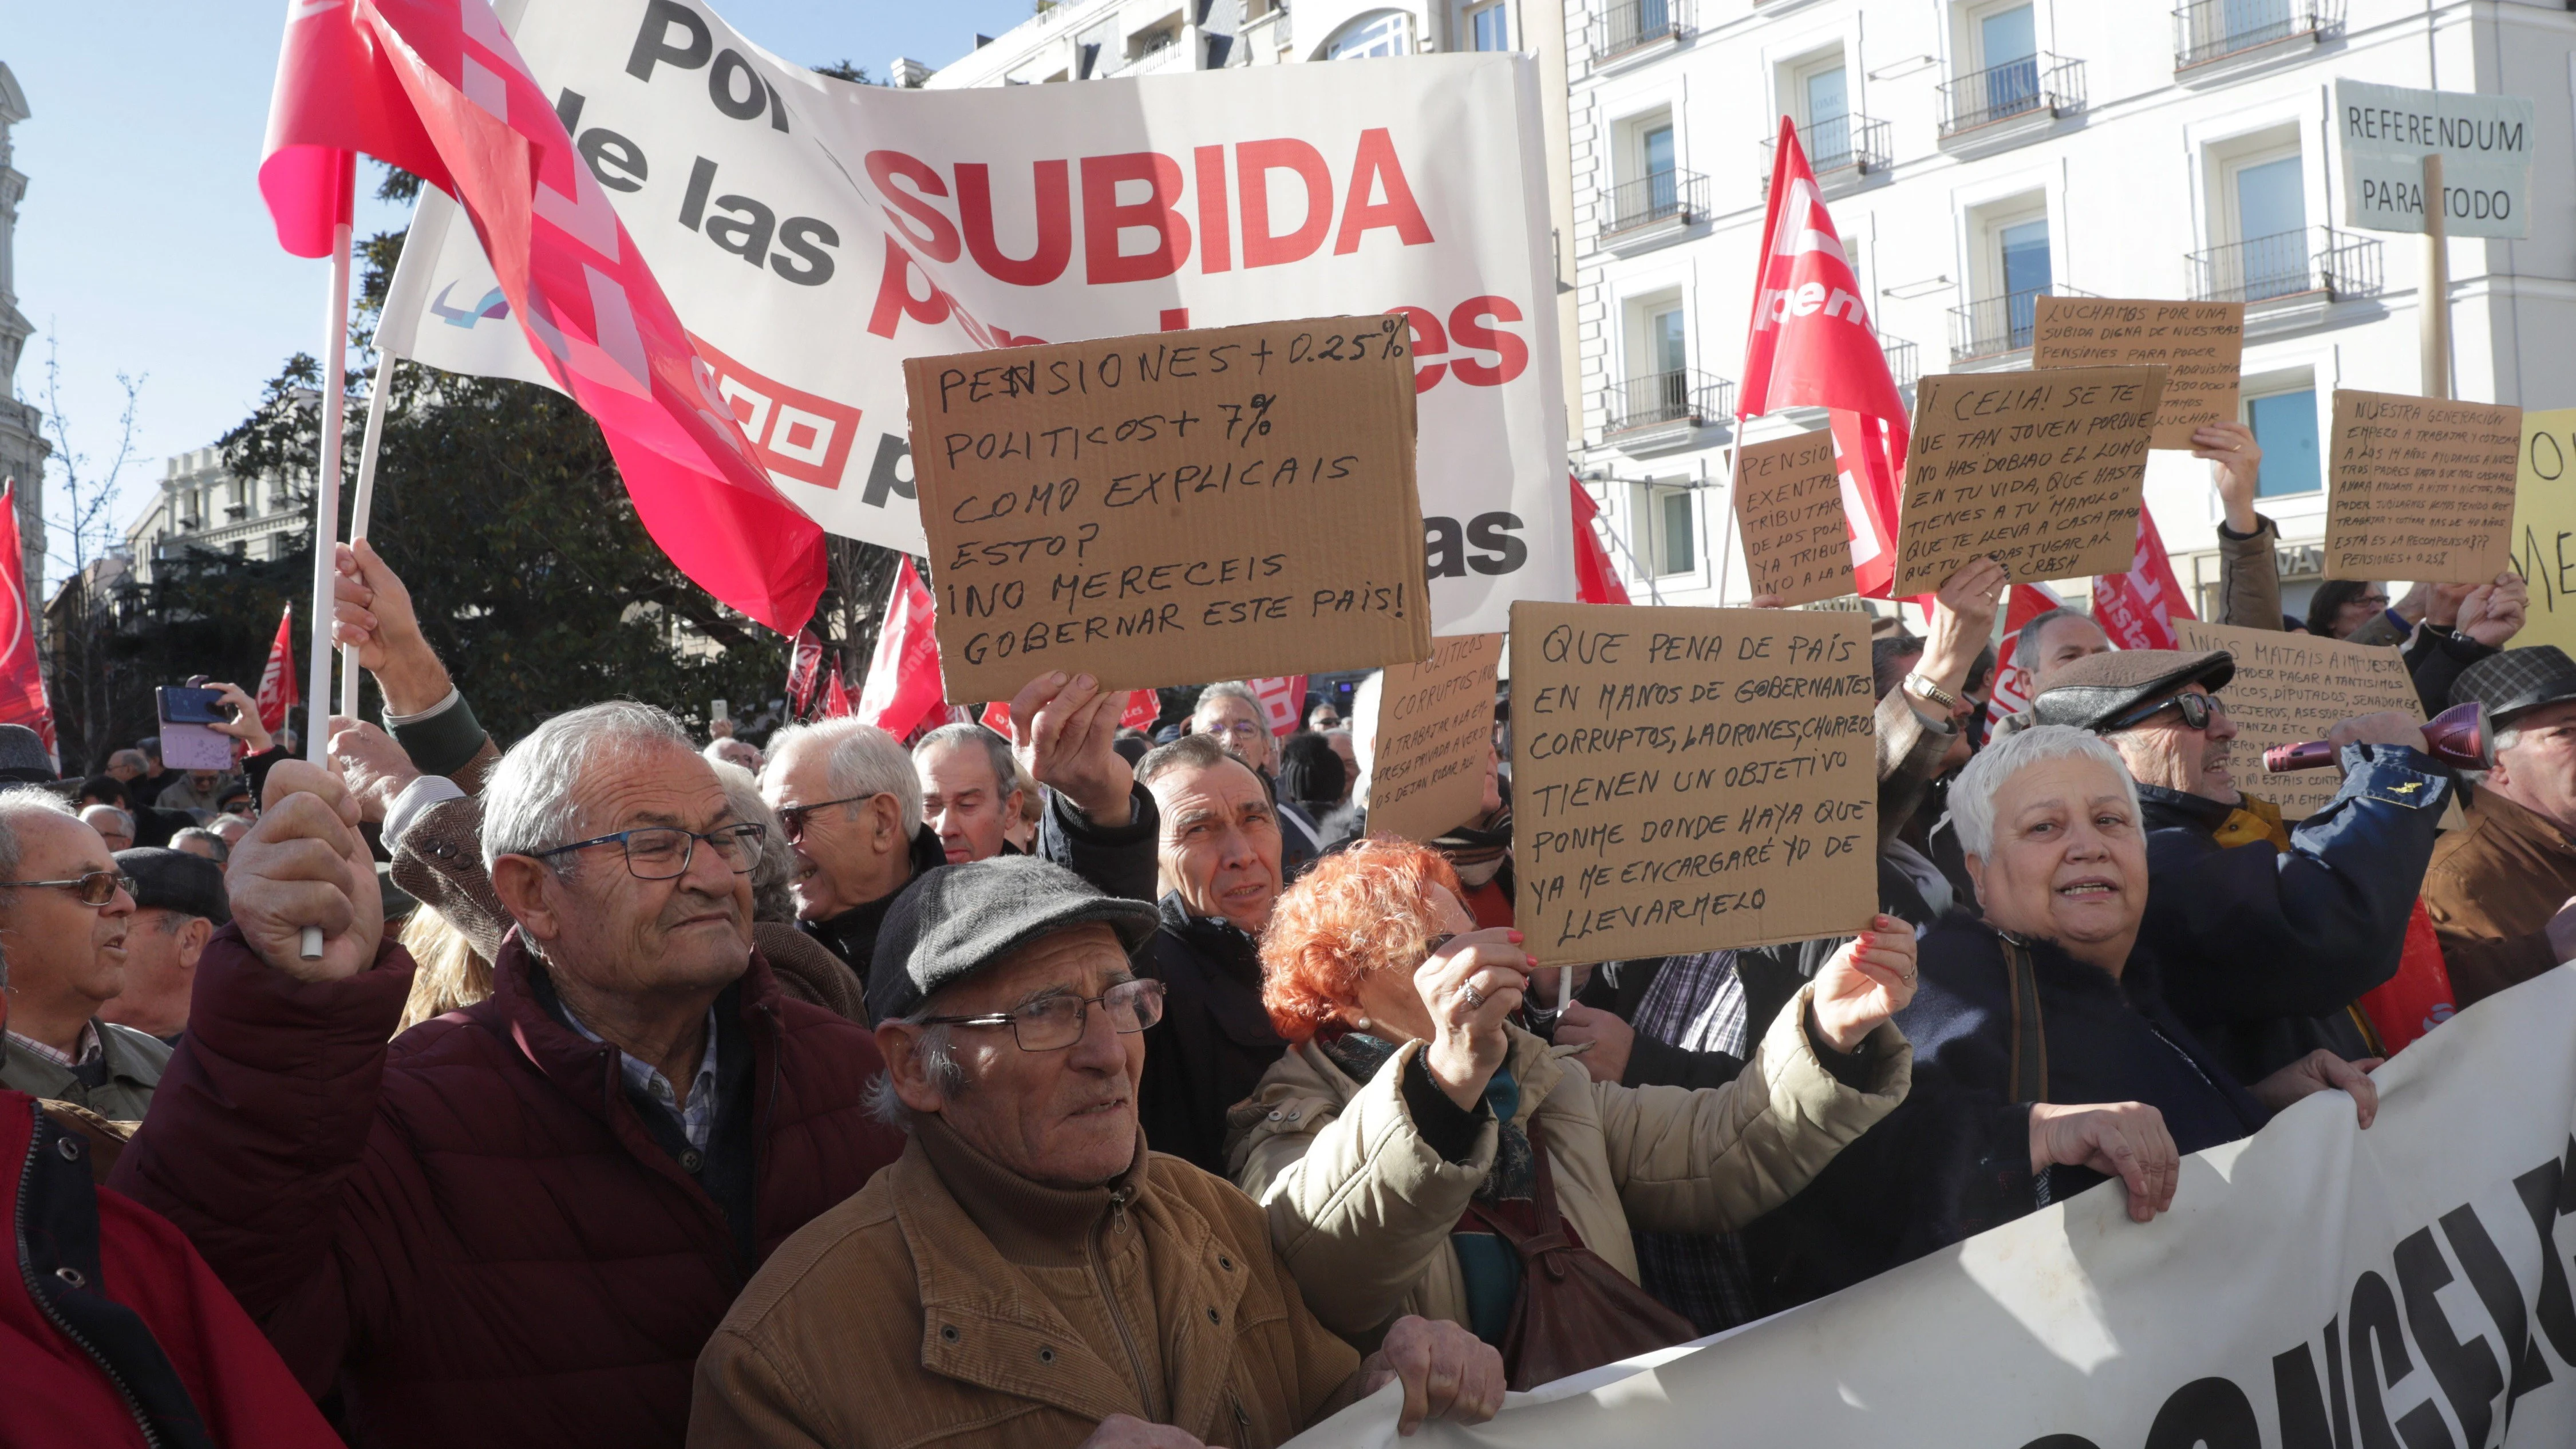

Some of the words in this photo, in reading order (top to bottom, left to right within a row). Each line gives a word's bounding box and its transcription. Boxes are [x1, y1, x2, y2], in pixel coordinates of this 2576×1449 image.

[2349, 106, 2523, 152] REFERENDUM
[864, 127, 1435, 286] SUBIDA
[2363, 179, 2424, 214] PARA
[2443, 187, 2511, 220] TODO
[678, 156, 840, 287] las
[2045, 304, 2148, 322] LUCHAMOS
[2157, 306, 2189, 321] POR
[2196, 307, 2227, 321] UNA
[2041, 326, 2093, 341] SUBIDA
[2101, 326, 2142, 339] DIGNA
[2148, 326, 2169, 337] DE
[2172, 325, 2239, 337] NUESTRAS
[939, 344, 1240, 413] PENSIONES
[1251, 338, 1273, 375] +
[1289, 318, 1405, 364] 0.25%
[2042, 346, 2117, 358] PENSIONES
[2127, 348, 2167, 361] PARA
[2172, 347, 2215, 358] PODER
[1218, 393, 1277, 448] 7%
[1955, 385, 2051, 421] CELIA!
[2063, 386, 2101, 408] SE
[2111, 384, 2143, 402] TE
[2154, 412, 2219, 425] LUCHAR
[2355, 401, 2420, 421] NUESTRA
[1958, 428, 2002, 449] TAN
[2010, 419, 2083, 443] JOVEN
[2087, 411, 2152, 435] PORQUE
[2404, 429, 2411, 440] A
[2416, 430, 2468, 443] TRABAJAR
[1741, 444, 1833, 485] PENSIO
[1915, 465, 1937, 486] NO
[1945, 459, 1978, 479] HAS
[2061, 447, 2086, 464] EL
[2339, 465, 2368, 475] TROS
[2374, 465, 2410, 476] PADRES
[2344, 447, 2353, 459] A
[2358, 445, 2383, 460] LOS
[2388, 447, 2401, 460] 14
[2431, 452, 2480, 465] AYUDAMOS
[953, 477, 1080, 523] COMO
[1104, 456, 1358, 507] EXPLICAIS
[1747, 473, 1839, 513] EXENTAS
[1911, 488, 1946, 509] EN
[1954, 485, 1983, 504] TU
[1991, 480, 2040, 498] VIDA,
[2045, 471, 2088, 493] QUE
[2093, 464, 2147, 485] HASTA
[2338, 480, 2372, 494] AHORA
[1747, 498, 1843, 533] TRIBUTAR
[1908, 508, 1986, 538] TIENES
[1994, 505, 2007, 520] A
[2014, 502, 2039, 518] TU
[2336, 500, 2370, 513] PODER
[2458, 501, 2488, 512] TENIDO
[950, 523, 1099, 570] ESTO?
[1752, 539, 1771, 556] DE
[1776, 530, 1807, 547] LOS
[1906, 537, 1948, 562] QUE
[1952, 533, 1974, 550] TE
[1979, 522, 2030, 546] LLEVA
[2036, 520, 2048, 535] A
[2056, 511, 2103, 531] CASA
[2104, 507, 2139, 530] PARA
[2370, 535, 2387, 546] ES
[2391, 535, 2404, 546] LA
[1755, 559, 1780, 579] YA
[1905, 562, 1935, 582] QUE
[1940, 558, 1960, 571] TU
[2028, 536, 2086, 558] JUGAR
[2087, 531, 2112, 548] AL
[2341, 552, 2404, 568] PENSIONES
[1052, 554, 1286, 615] MERECEIS
[1803, 572, 1811, 587] A
[1819, 567, 1834, 582] LA
[965, 603, 1184, 665] GOBERNAR
[1203, 596, 1293, 626] ESTE
[1543, 625, 1629, 664] QUE
[1649, 633, 1722, 663] PENA
[1738, 635, 1773, 660] DE
[2255, 642, 2322, 667] MATAIS
[2330, 652, 2338, 669] A
[2343, 654, 2404, 674] IMPUESTOS
[1394, 670, 1477, 720] CORRUPTOS
[1534, 684, 1579, 713] EN
[1598, 682, 1683, 721] MANOS
[1689, 681, 1725, 704] DE
[1735, 674, 1872, 703] GOBERNANTES
[2237, 667, 2274, 680] PODER
[2279, 670, 2320, 685] PAGAR
[2325, 675, 2331, 685] A
[2335, 676, 2404, 692] TANTISIMOS
[1382, 737, 1392, 759] A
[1396, 717, 1449, 755] TRABAJAR
[1530, 726, 1677, 760] CORRUPTOS,
[2282, 724, 2309, 735] ETC
[1414, 741, 1451, 771] PRIVADA
[1452, 737, 1460, 753] A
[1462, 728, 1479, 748] VER
[1376, 792, 1391, 809] OS
[1394, 776, 1428, 802] DEJAN
[1431, 761, 1457, 786] ROBAR
[1532, 770, 1660, 817] TIENEN
[1674, 768, 1716, 792] UN
[1725, 748, 1847, 787] OBJETIVO
[2262, 774, 2302, 787] ESTAIS
[1532, 823, 1625, 863] PONME
[1641, 815, 1728, 843] DONDE
[1738, 803, 1802, 835] HAYA
[1815, 800, 1872, 824] QUE
[1531, 879, 1564, 916] YA
[1580, 864, 1613, 898] ME
[1621, 838, 1775, 883] ENCARGARÉ
[1784, 835, 1811, 867] YO
[1825, 835, 1861, 857] DE
[1558, 888, 1766, 947] LLEVARMELO
